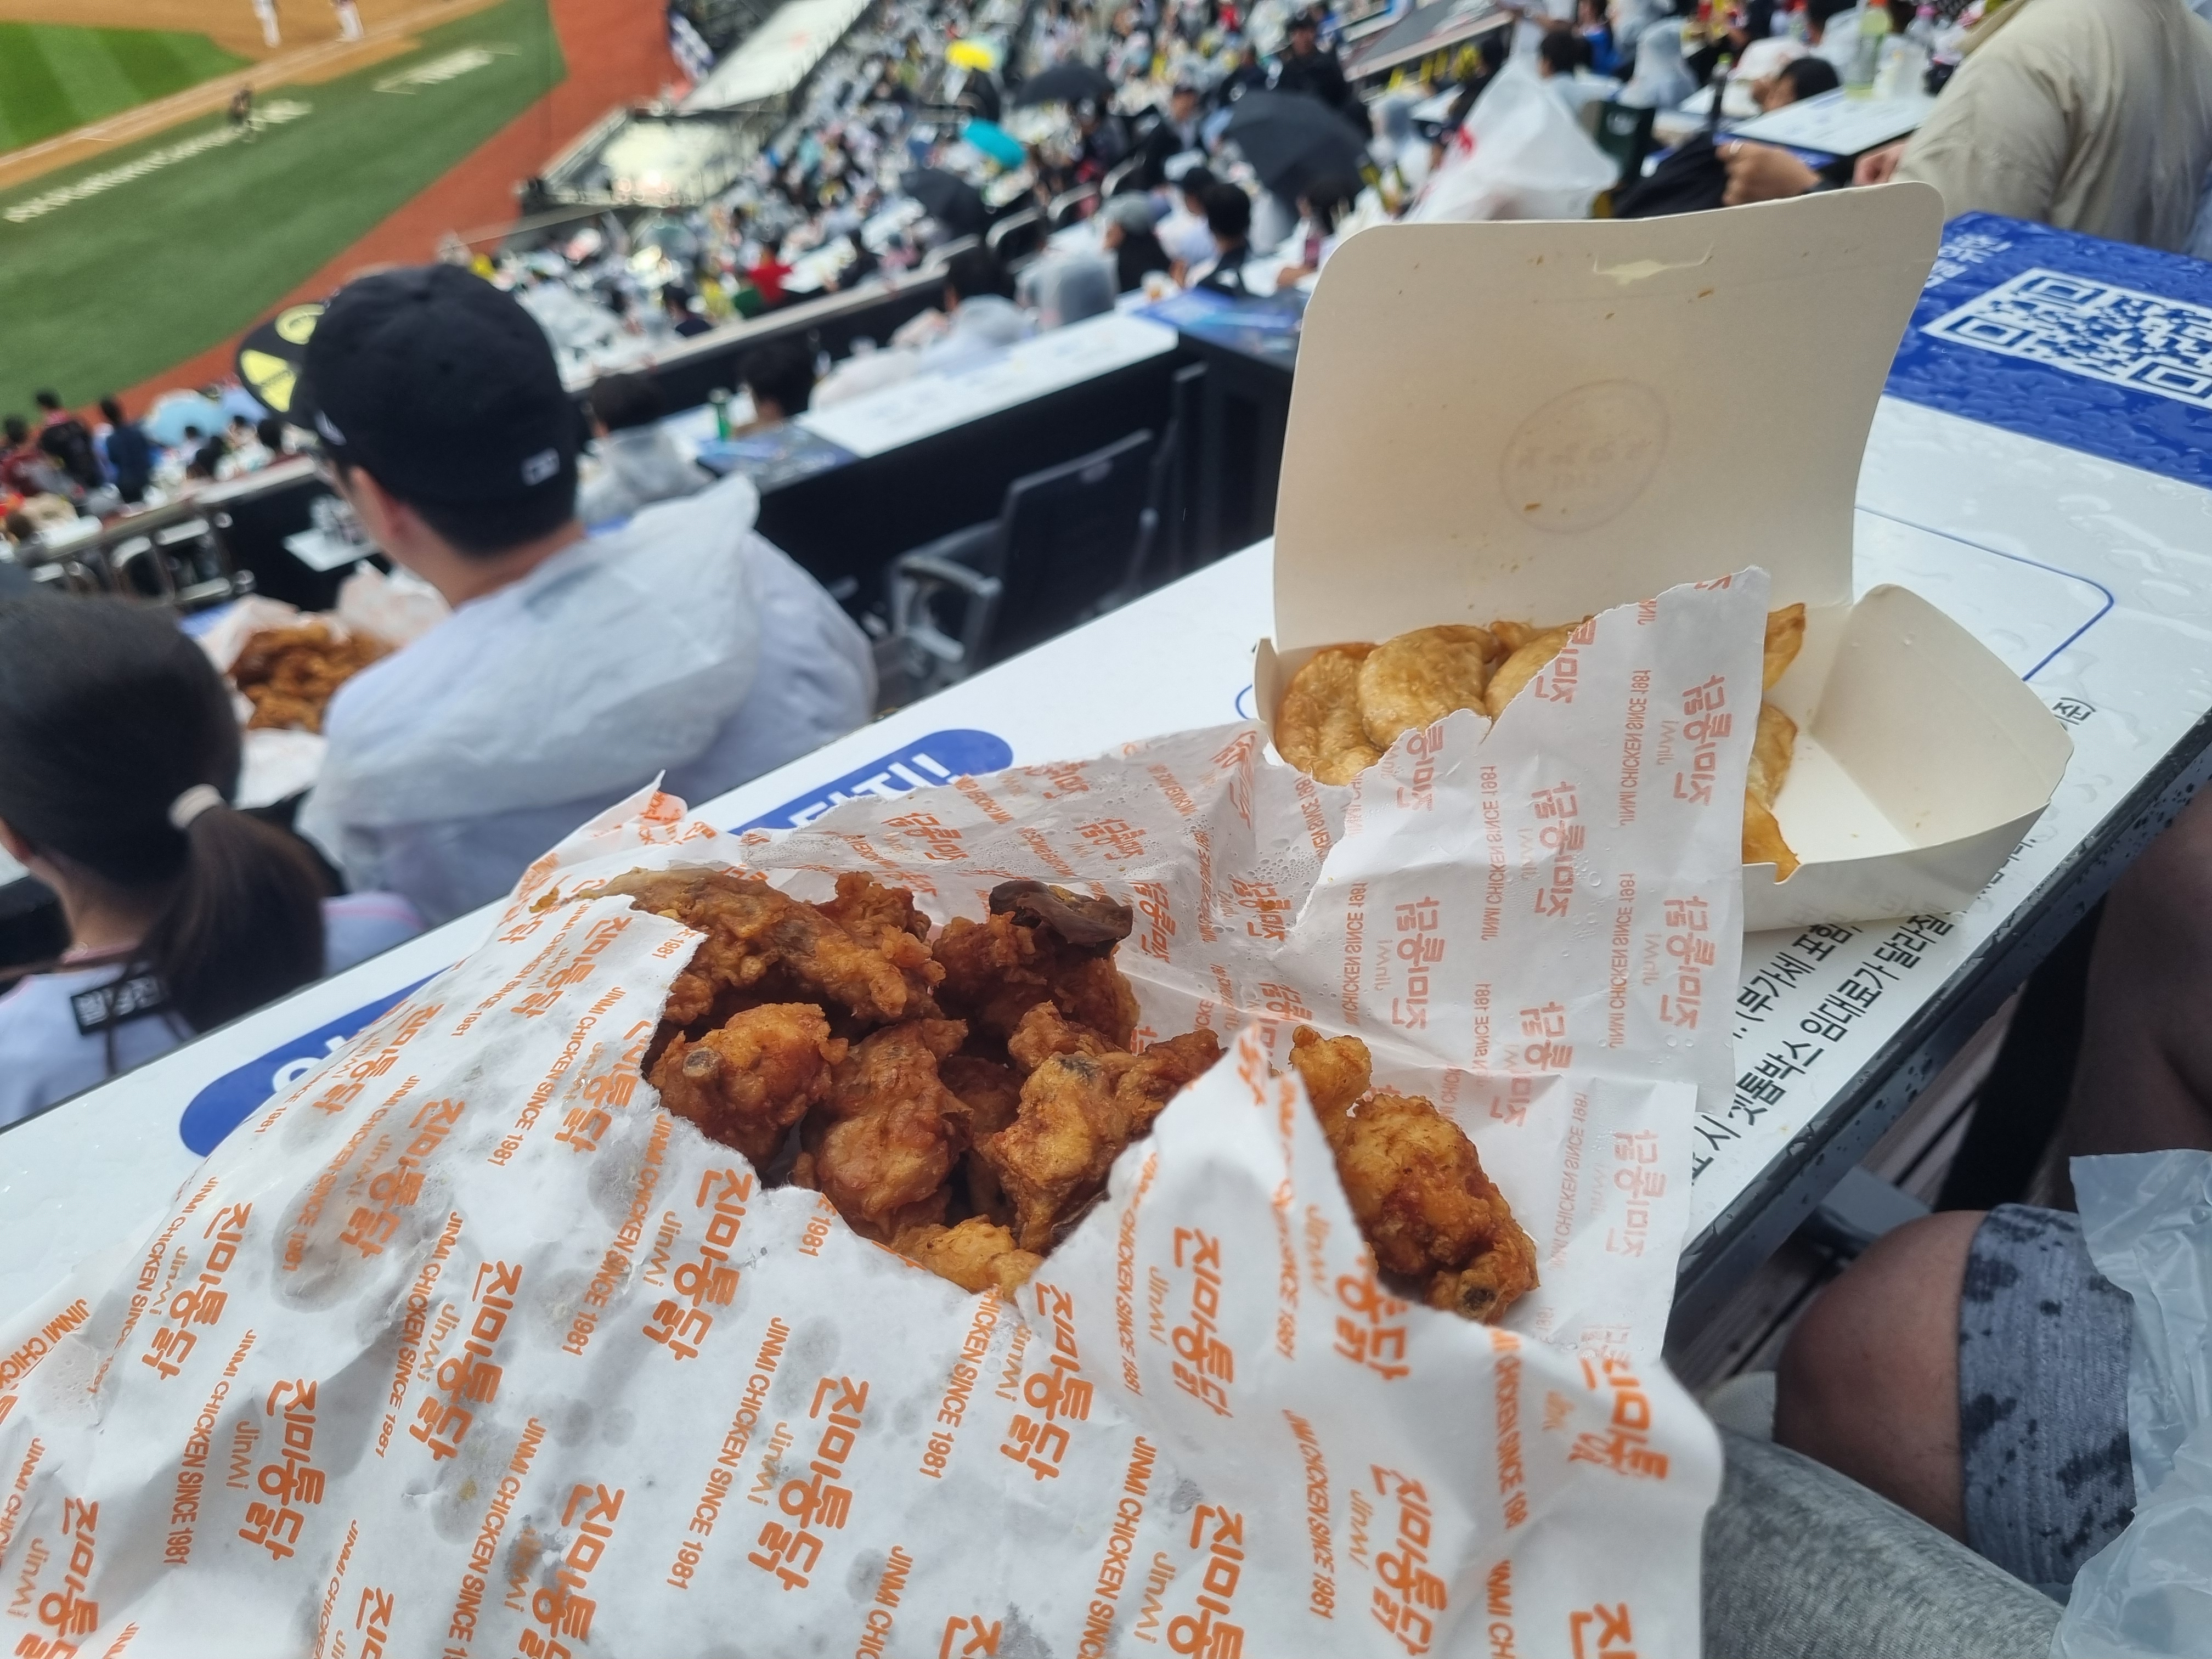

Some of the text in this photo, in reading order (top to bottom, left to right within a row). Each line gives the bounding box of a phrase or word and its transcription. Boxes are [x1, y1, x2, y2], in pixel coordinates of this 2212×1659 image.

[510, 916, 633, 1019] 진미통닭
[515, 933, 566, 979] CHICKEN
[561, 904, 591, 930] JINMI
[652, 938, 685, 959] 1981
[451, 1011, 482, 1036] 1981
[477, 980, 522, 1009] SINCE
[1799, 961, 1900, 1043] 임대료가
[1872, 913, 1956, 968] 달라질
[312, 1003, 444, 1115] 진미통닭
[383, 1075, 420, 1106] JINMI
[487, 986, 626, 1166] JINMI CHICKEN SINCE 1981
[255, 1107, 287, 1133] 1981
[328, 1108, 388, 1171] CHICKEN
[182, 1177, 218, 1213] JINMI
[340, 1098, 465, 1258] 진미통닭
[137, 1216, 185, 1291] CHICKEN
[142, 1203, 252, 1380] 진미통닭
[562, 1114, 673, 1356] JINMI CHICKEN SINCE 1981
[642, 1169, 753, 1361] 진미통닭
[798, 1216, 833, 1257] 1981
[42, 1299, 89, 1344] JINMI
[375, 1211, 463, 1459] JINMI CHICKEN SINCE 1981
[409, 1260, 523, 1461] 진미통닭
[1172, 1226, 1234, 1418] 진미통닭
[937, 1364, 978, 1427] SINCE
[1000, 1282, 1093, 1481] 진미통닭
[15, 1437, 45, 1491] JINMI
[163, 1329, 256, 1565] JINMI CHICKEN SINCE 1981
[239, 1379, 326, 1561] 진미통닭
[667, 1317, 791, 1590] JINMI CHICKEN SINCE 1981
[748, 1376, 869, 1591] 진미통닭
[919, 1432, 955, 1479] 1981
[449, 1417, 547, 1642] JINMI CHICKEN SINCE
[1077, 1436, 1156, 1659] JINMI CHICKEN SINC
[1167, 1504, 1245, 1659] 진미통
[1370, 1464, 1447, 1655] 진미통닭
[314, 1576, 340, 1659] CHICKE
[855, 1545, 913, 1659] JINMI CHIC
[1309, 1571, 1336, 1620] 1981
